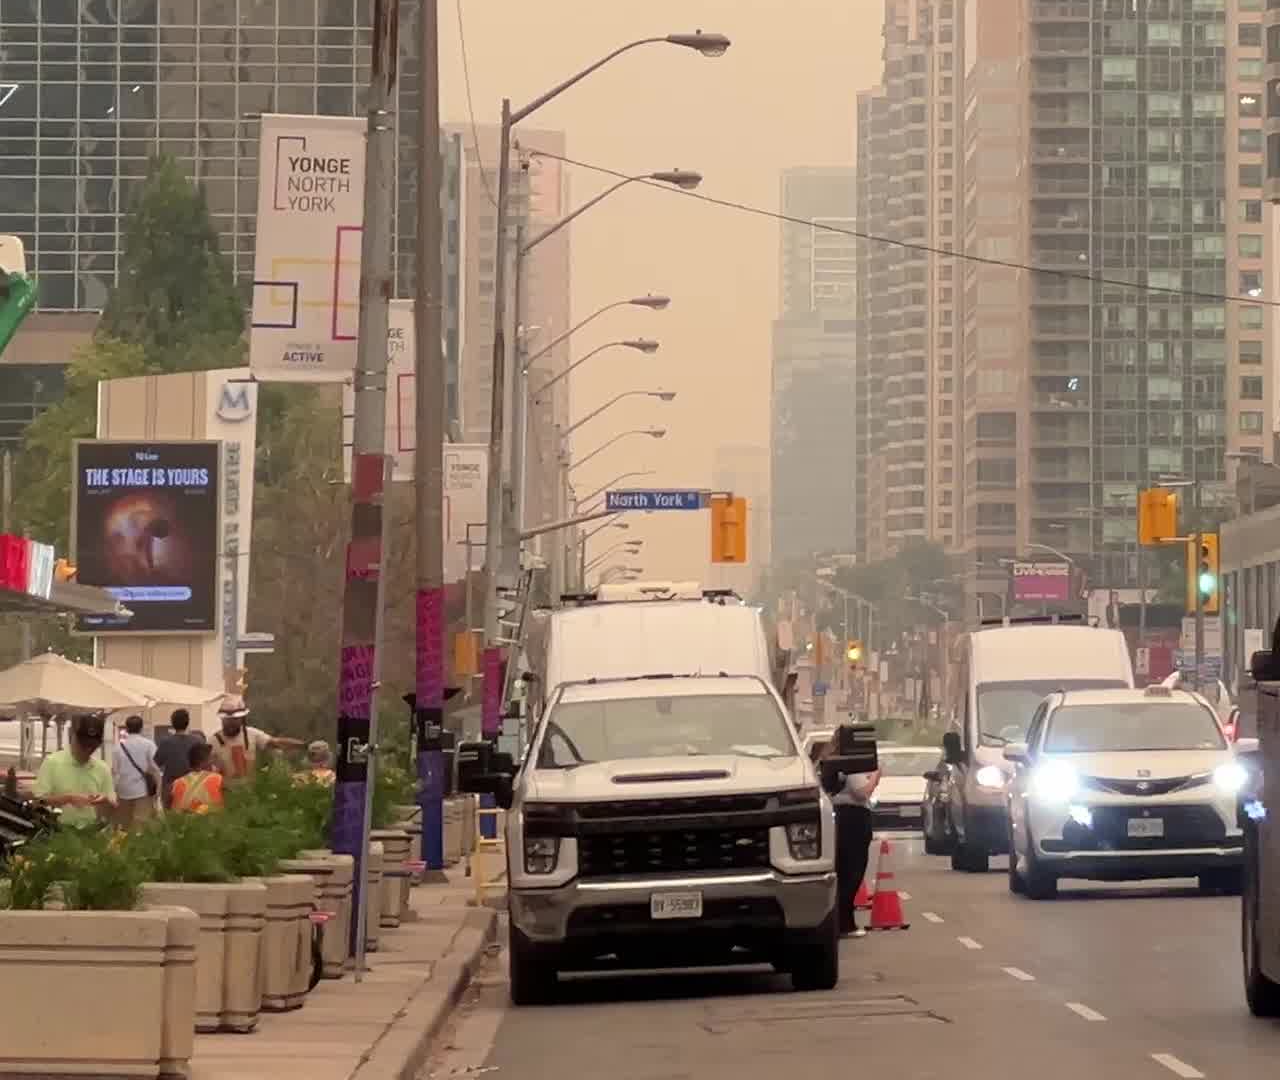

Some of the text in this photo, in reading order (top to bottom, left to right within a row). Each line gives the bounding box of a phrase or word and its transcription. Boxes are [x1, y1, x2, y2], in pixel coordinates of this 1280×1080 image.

[288, 156, 350, 174] YONGE
[288, 176, 350, 193] NORTH
[288, 195, 336, 212] YORK
[282, 351, 325, 363] ACTIVE
[85, 468, 209, 486] THE STAGE IS YOURS
[610, 493, 648, 507] North
[653, 493, 682, 507] York
